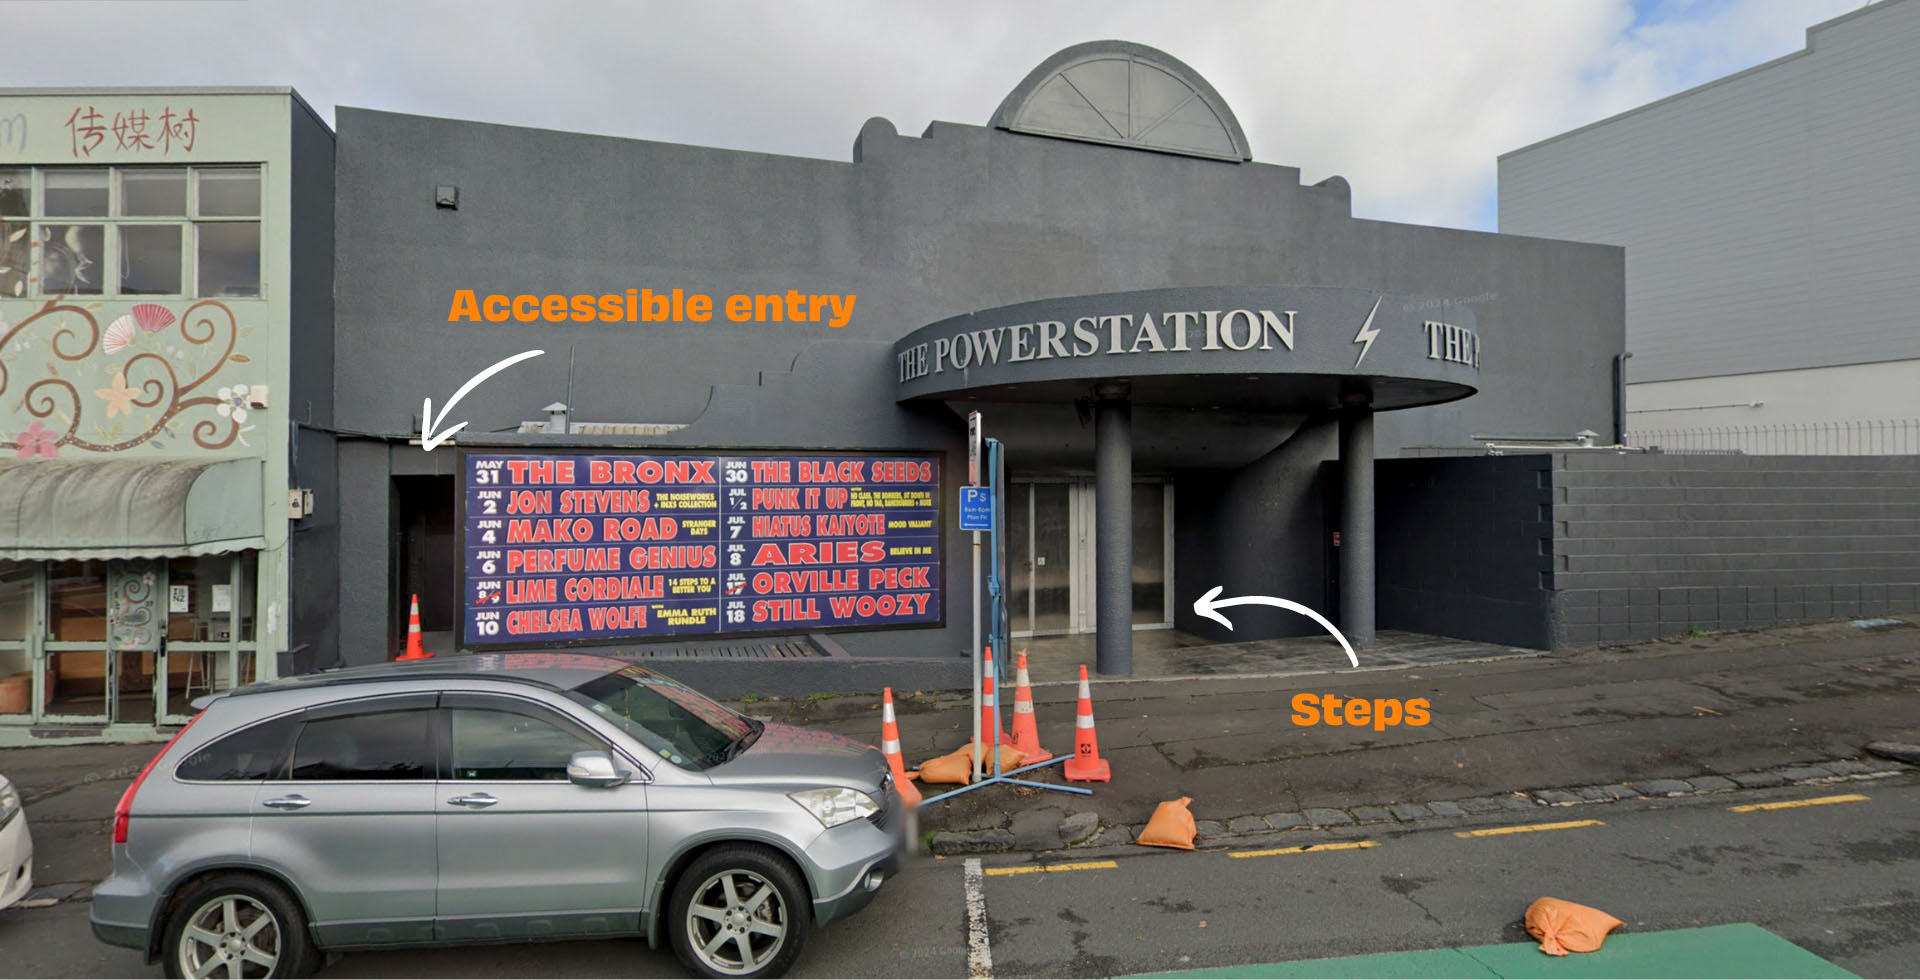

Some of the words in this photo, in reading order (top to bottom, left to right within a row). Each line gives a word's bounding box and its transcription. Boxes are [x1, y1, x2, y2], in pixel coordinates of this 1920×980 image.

[64, 105, 200, 157] 传媒树
[898, 342, 929, 383] THE
[935, 308, 1298, 373] POWERSTATION
[1423, 320, 1472, 366] THE
[476, 461, 504, 469] MAY
[507, 460, 575, 484] THE
[589, 461, 716, 484] BRONX
[725, 461, 747, 469] JUN
[751, 461, 791, 483] THE
[798, 461, 865, 483] BLACK
[871, 461, 931, 483] SEEDS
[476, 470, 499, 484] 31
[725, 470, 748, 483] 30
[477, 491, 501, 499] JUN
[728, 488, 747, 497] JUL
[752, 487, 800, 510] PUNK
[805, 487, 821, 510] IT
[826, 487, 848, 510] UP
[482, 500, 497, 514] 2
[506, 490, 552, 515] JON
[560, 490, 650, 513] STEVENS
[678, 500, 717, 509] COLLECTION
[477, 520, 501, 528] JUN
[682, 520, 717, 528] STRANGER
[727, 516, 746, 525] JUL
[752, 514, 811, 538] HIATUS
[816, 513, 886, 536] KAIYOTE
[482, 530, 496, 544] 4
[506, 518, 594, 543] MAKO
[603, 517, 678, 541] ROAD
[730, 525, 743, 539] 7
[476, 551, 501, 559] JUN
[727, 544, 746, 552] JUL
[751, 541, 886, 566] ARIES
[507, 548, 620, 574] PERFUME
[629, 545, 716, 570] GENIUS
[730, 552, 742, 566] 8
[482, 560, 496, 574] 6
[679, 577, 699, 586] STEPS
[700, 576, 710, 585] TO
[710, 576, 716, 585] A
[727, 573, 746, 581] JUL
[752, 570, 859, 595] ORVILLE
[869, 566, 931, 590] PECK
[476, 581, 501, 590] JUN
[506, 578, 557, 604] LIME
[564, 575, 664, 601] CORDIALE
[697, 584, 712, 593] YOU
[727, 601, 746, 609] JUL
[752, 598, 821, 623] STILL
[829, 593, 931, 619] WOOZY
[475, 612, 499, 620] JUN
[657, 608, 689, 618] EMMA
[691, 607, 717, 616] RUTH
[726, 609, 746, 624] 18
[506, 608, 583, 635] CHELSEA
[588, 605, 647, 630] WOLFE
[667, 616, 706, 626] RUNDLE
[477, 621, 499, 635] 10
